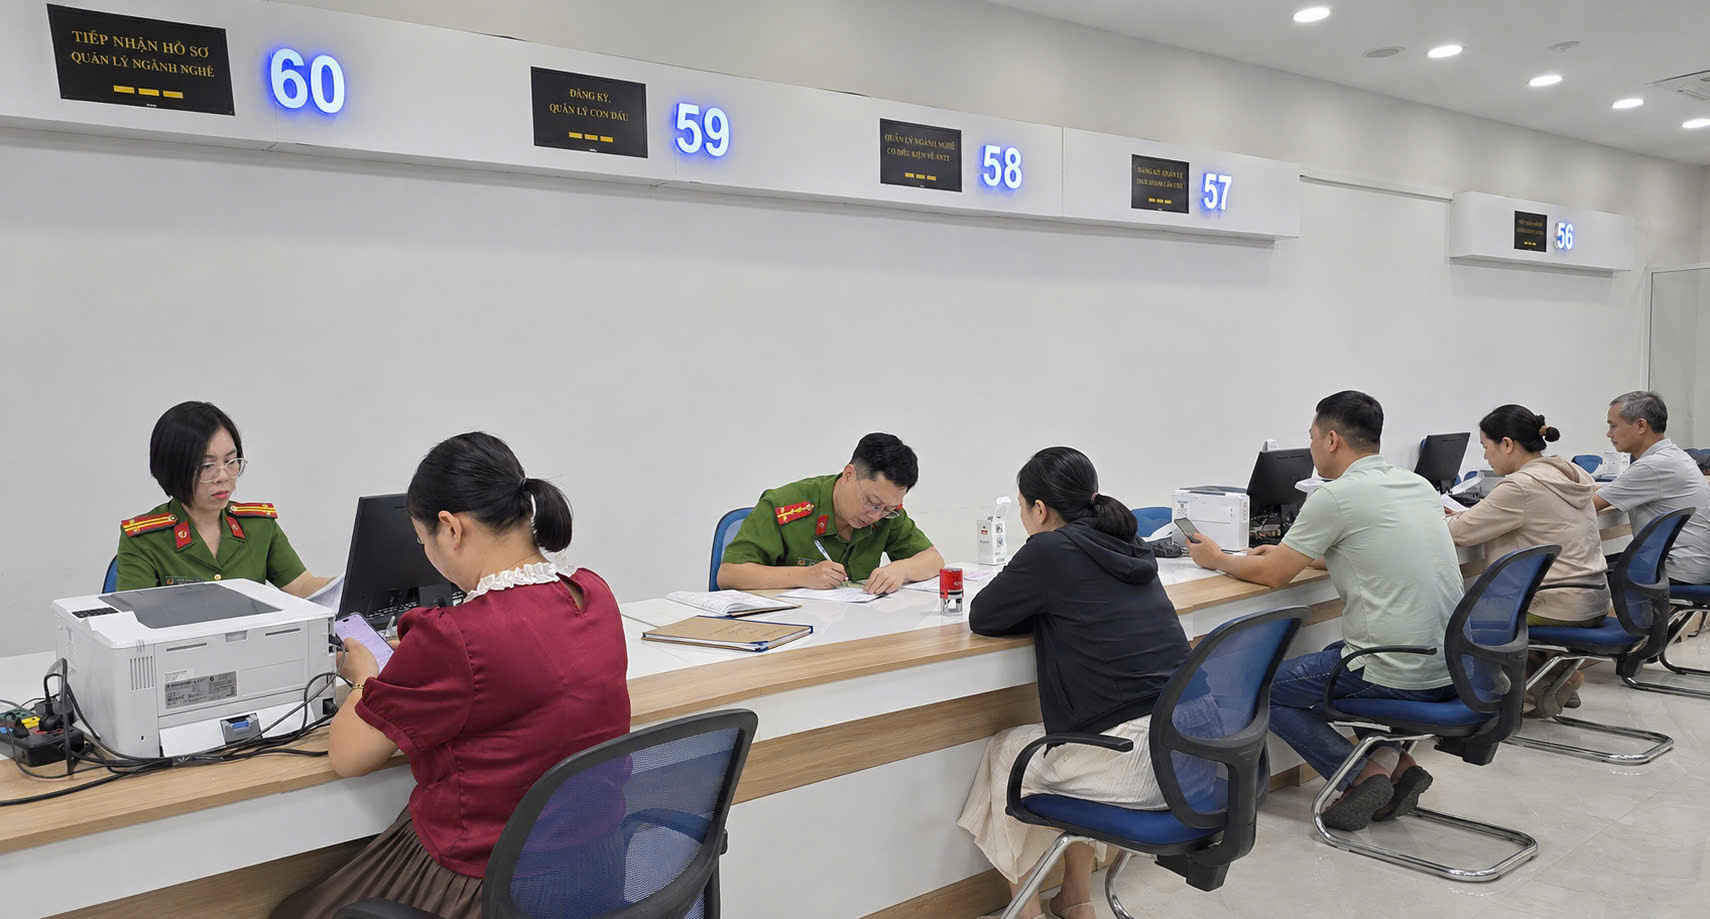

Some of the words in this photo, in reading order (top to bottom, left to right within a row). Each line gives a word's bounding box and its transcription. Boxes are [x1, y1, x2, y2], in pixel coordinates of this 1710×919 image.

[71, 51, 109, 65] QUẢN
[113, 55, 129, 68] LÝ
[132, 58, 178, 74] NGÀNH
[112, 35, 158, 53] NHẬN
[190, 46, 209, 58] SƠ
[271, 48, 345, 114] 60
[549, 103, 575, 115] QUẢN
[577, 105, 588, 117] LÝ
[590, 109, 609, 119] CON
[676, 103, 729, 157] 59
[983, 144, 1022, 189] 58
[1203, 173, 1232, 210] 57
[1557, 222, 1573, 250] 56
